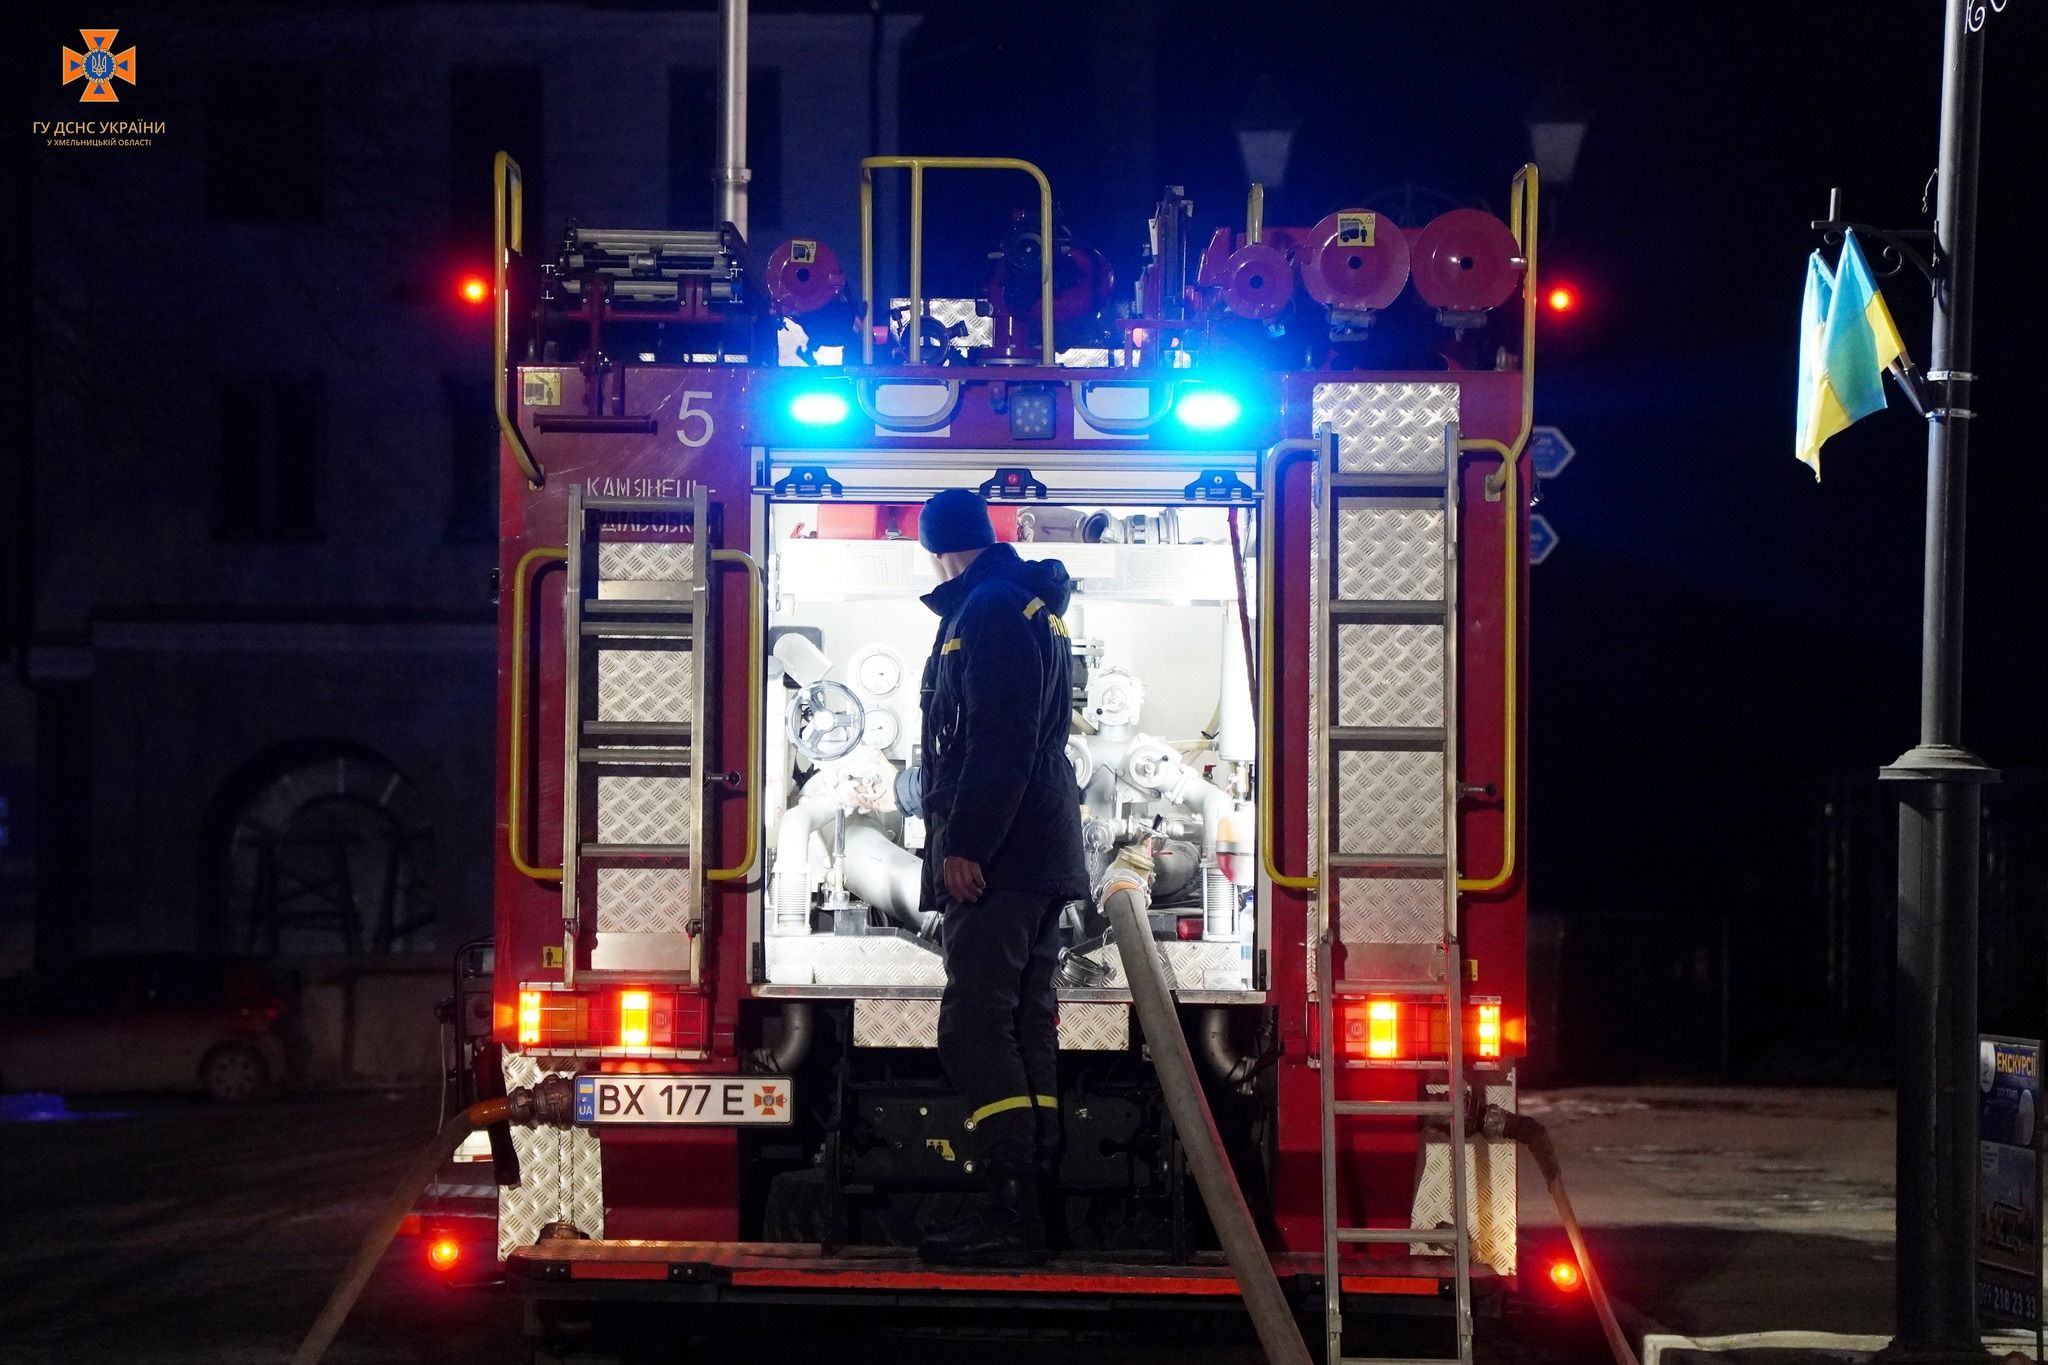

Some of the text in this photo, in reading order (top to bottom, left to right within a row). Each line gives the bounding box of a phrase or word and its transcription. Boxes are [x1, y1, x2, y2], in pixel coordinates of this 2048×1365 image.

[676, 390, 714, 448] 5
[578, 1107, 593, 1116] UA
[659, 1084, 711, 1116] 177
